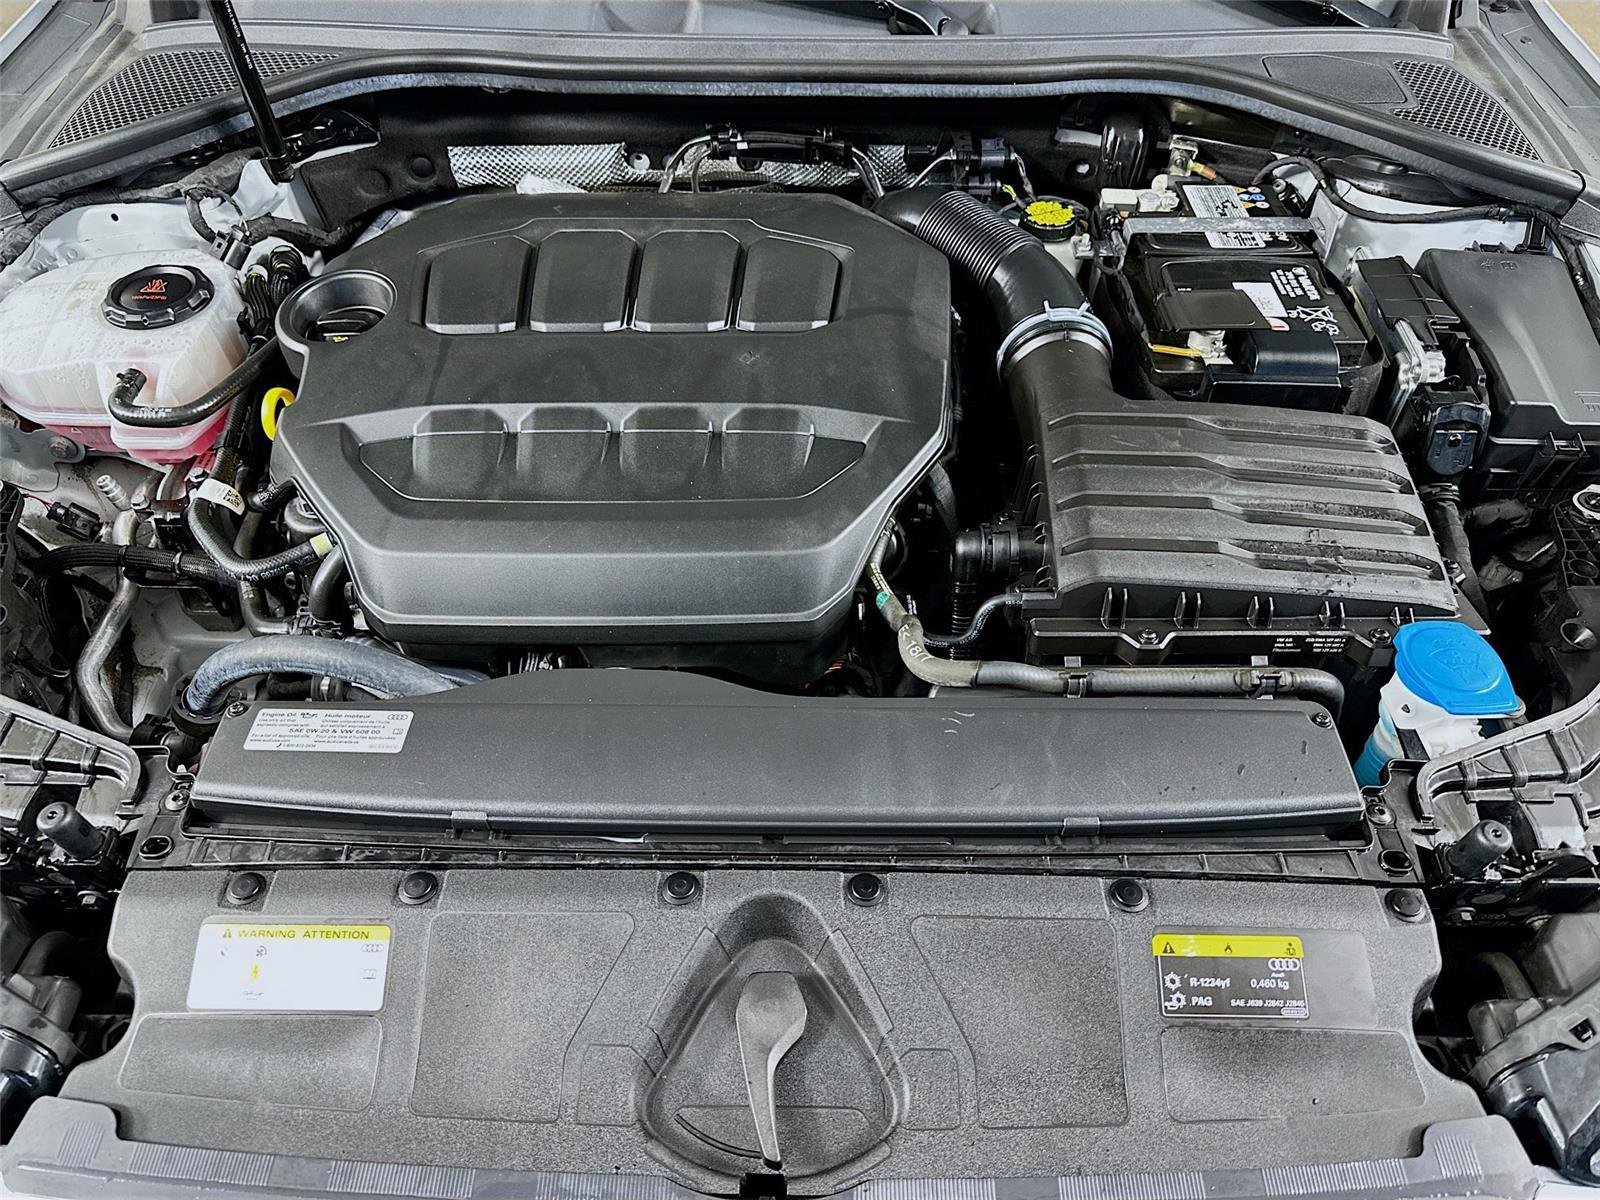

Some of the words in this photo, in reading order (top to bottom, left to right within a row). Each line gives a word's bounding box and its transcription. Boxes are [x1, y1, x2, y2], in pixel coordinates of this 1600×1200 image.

[238, 930, 296, 938] WARNING
[302, 930, 369, 939] ATTENTION
[1189, 977, 1231, 989] R-1234yf
[1278, 979, 1290, 990] kg
[1191, 996, 1213, 1006] PAG
[1230, 999, 1245, 1007] SAE
